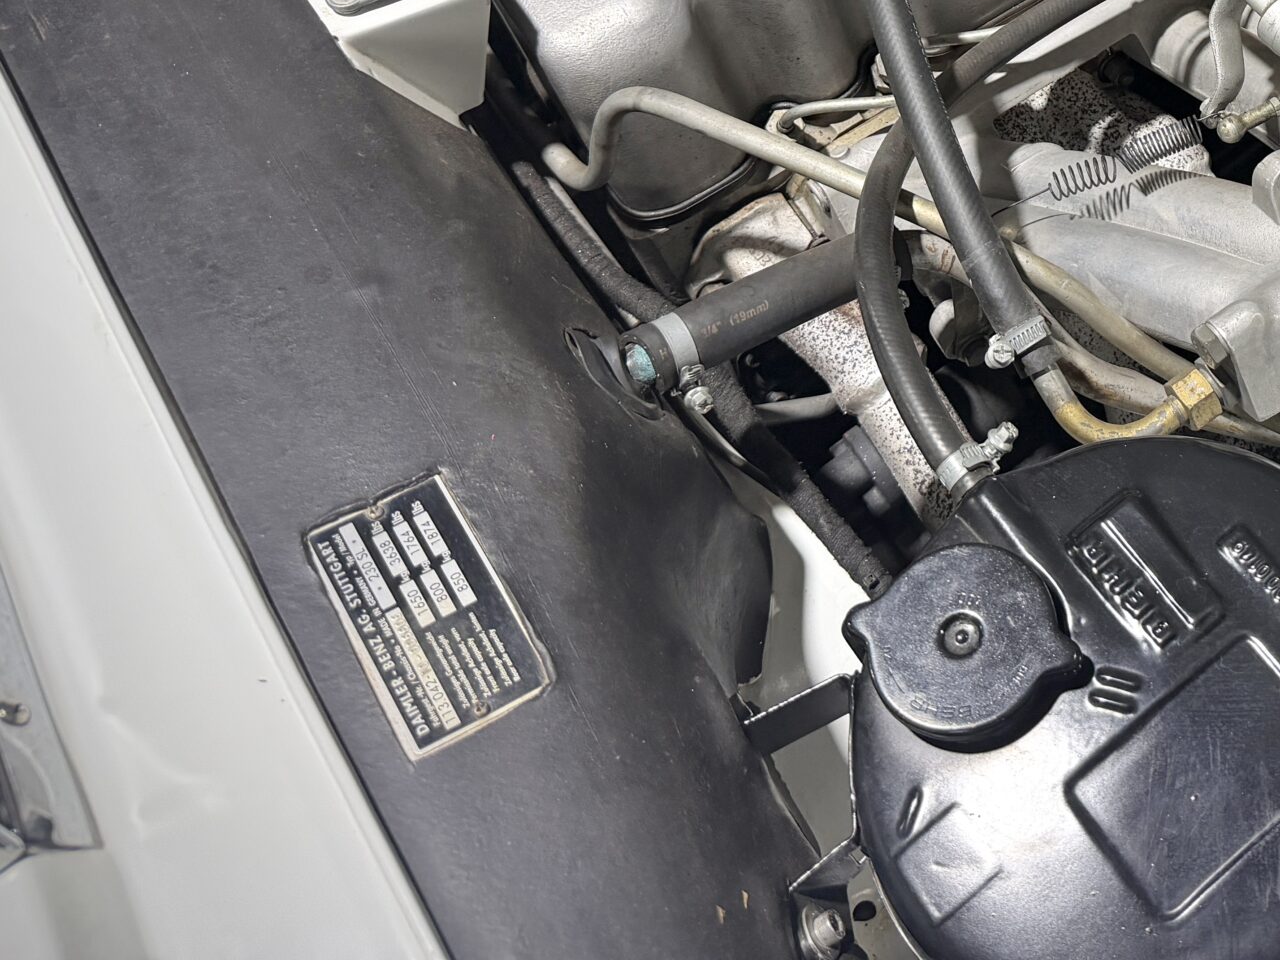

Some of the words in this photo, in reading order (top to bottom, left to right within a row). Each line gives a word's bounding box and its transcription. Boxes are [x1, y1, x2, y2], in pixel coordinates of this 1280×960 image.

[729, 300, 769, 327] (19mm)
[387, 509, 405, 525] lbs
[407, 499, 425, 515] lbs
[367, 519, 384, 535] lbs
[419, 519, 442, 546] 1874
[353, 546, 369, 561] SL
[378, 538, 401, 567] 3638
[399, 529, 421, 555] 1764
[316, 538, 363, 609] STUTTGART
[360, 559, 380, 582] 230
[448, 570, 469, 593] 850
[353, 574, 377, 607] GERMANY
[405, 587, 429, 616] 1650
[427, 580, 448, 603] 800
[376, 616, 393, 638] MADE
